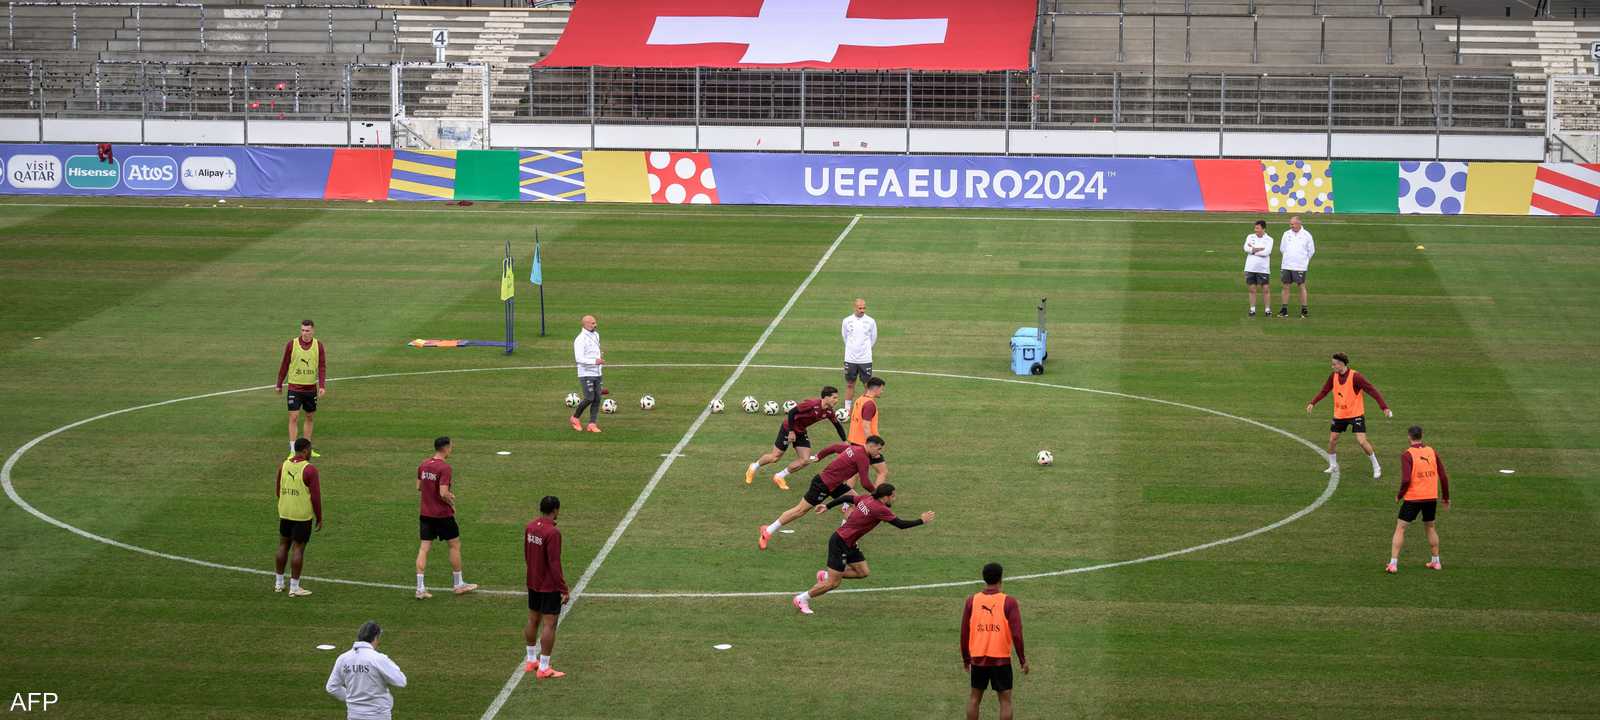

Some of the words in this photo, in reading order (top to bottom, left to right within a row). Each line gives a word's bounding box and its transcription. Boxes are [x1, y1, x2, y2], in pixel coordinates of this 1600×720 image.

[435, 31, 446, 45] 4
[26, 160, 55, 171] visit
[14, 170, 55, 183] QATAR
[68, 167, 117, 177] Hisense
[985, 624, 1001, 632] UBS
[352, 664, 370, 673] UBS
